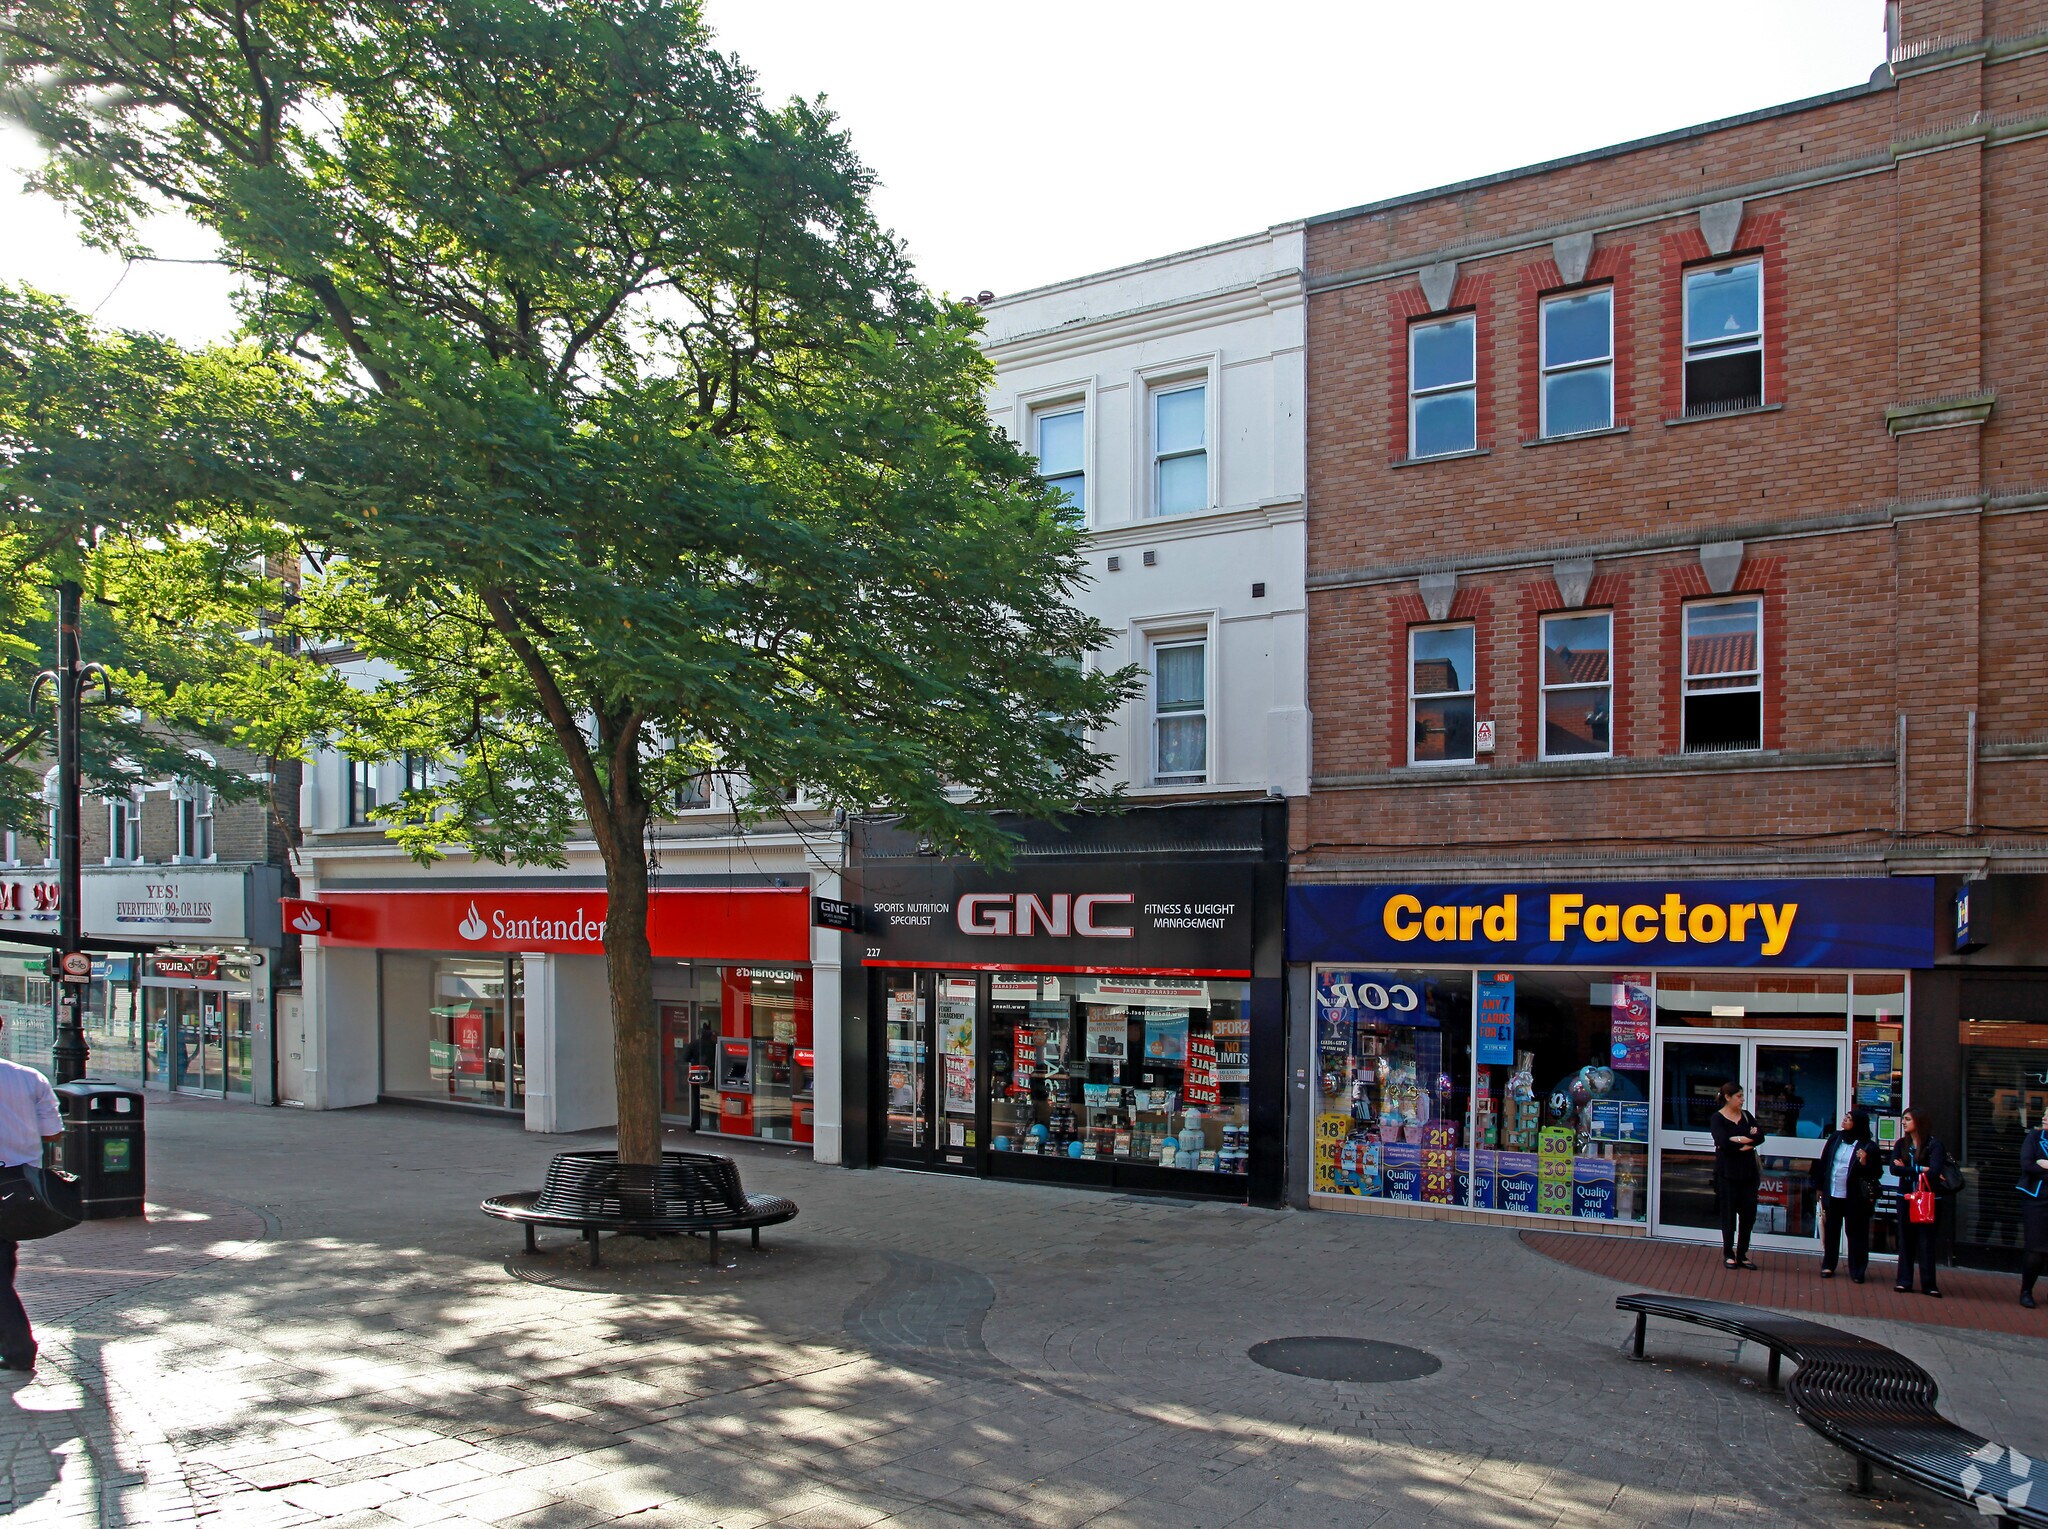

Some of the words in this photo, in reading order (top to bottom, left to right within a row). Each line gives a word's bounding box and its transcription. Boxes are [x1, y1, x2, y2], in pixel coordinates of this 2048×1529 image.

[146, 884, 180, 899] YES!
[117, 902, 165, 917] EVERYTHING
[165, 902, 180, 917] 99p
[181, 902, 193, 916] OR
[193, 902, 212, 917] LESS
[820, 901, 849, 915] GNC
[874, 903, 905, 913] SPORTS
[907, 903, 949, 913] NUTRITION
[1144, 903, 1182, 915] FITNESS
[1183, 904, 1192, 914] &
[1194, 903, 1235, 915] WEIGHT
[890, 915, 931, 926] SPECIALIST
[957, 893, 1134, 938] GNC
[492, 907, 608, 941] Santander
[1153, 918, 1225, 929] MANAGEMENT
[1382, 893, 1518, 942] Card
[1549, 893, 1799, 956] Factory
[866, 948, 881, 957] 227
[1482, 999, 1501, 1010] ANY
[1501, 996, 1510, 1012] 7
[1629, 1004, 1644, 1017] 21
[1481, 1013, 1511, 1025] CARDS
[1215, 1021, 1250, 1034] 3FOR2
[1479, 1026, 1497, 1038] FOR
[1497, 1026, 1512, 1041] £1
[1614, 1035, 1623, 1043] 18
[1636, 1032, 1650, 1041] 99p
[1224, 1042, 1240, 1052] NO
[1215, 1052, 1249, 1064] LIMITS
[1321, 1122, 1339, 1138] 18
[1429, 1129, 1448, 1146] 21
[1320, 1144, 1335, 1158] 18
[1543, 1138, 1567, 1153] 30
[1427, 1151, 1446, 1168] 21
[1320, 1164, 1335, 1179] 18
[1386, 1169, 1417, 1182] Quality
[1543, 1161, 1567, 1177] 30
[1393, 1181, 1410, 1190] and
[1427, 1174, 1446, 1190] 21
[1458, 1175, 1490, 1190] Qulity
[1501, 1179, 1534, 1194] Quality
[1758, 1180, 1784, 1192] AVE
[1390, 1191, 1413, 1201] Value
[1508, 1192, 1526, 1201] and
[1543, 1183, 1567, 1199] 30
[1576, 1185, 1611, 1199] Quality
[1504, 1201, 1530, 1212] Value
[1584, 1199, 1602, 1208] and
[1580, 1208, 1606, 1219] Value
